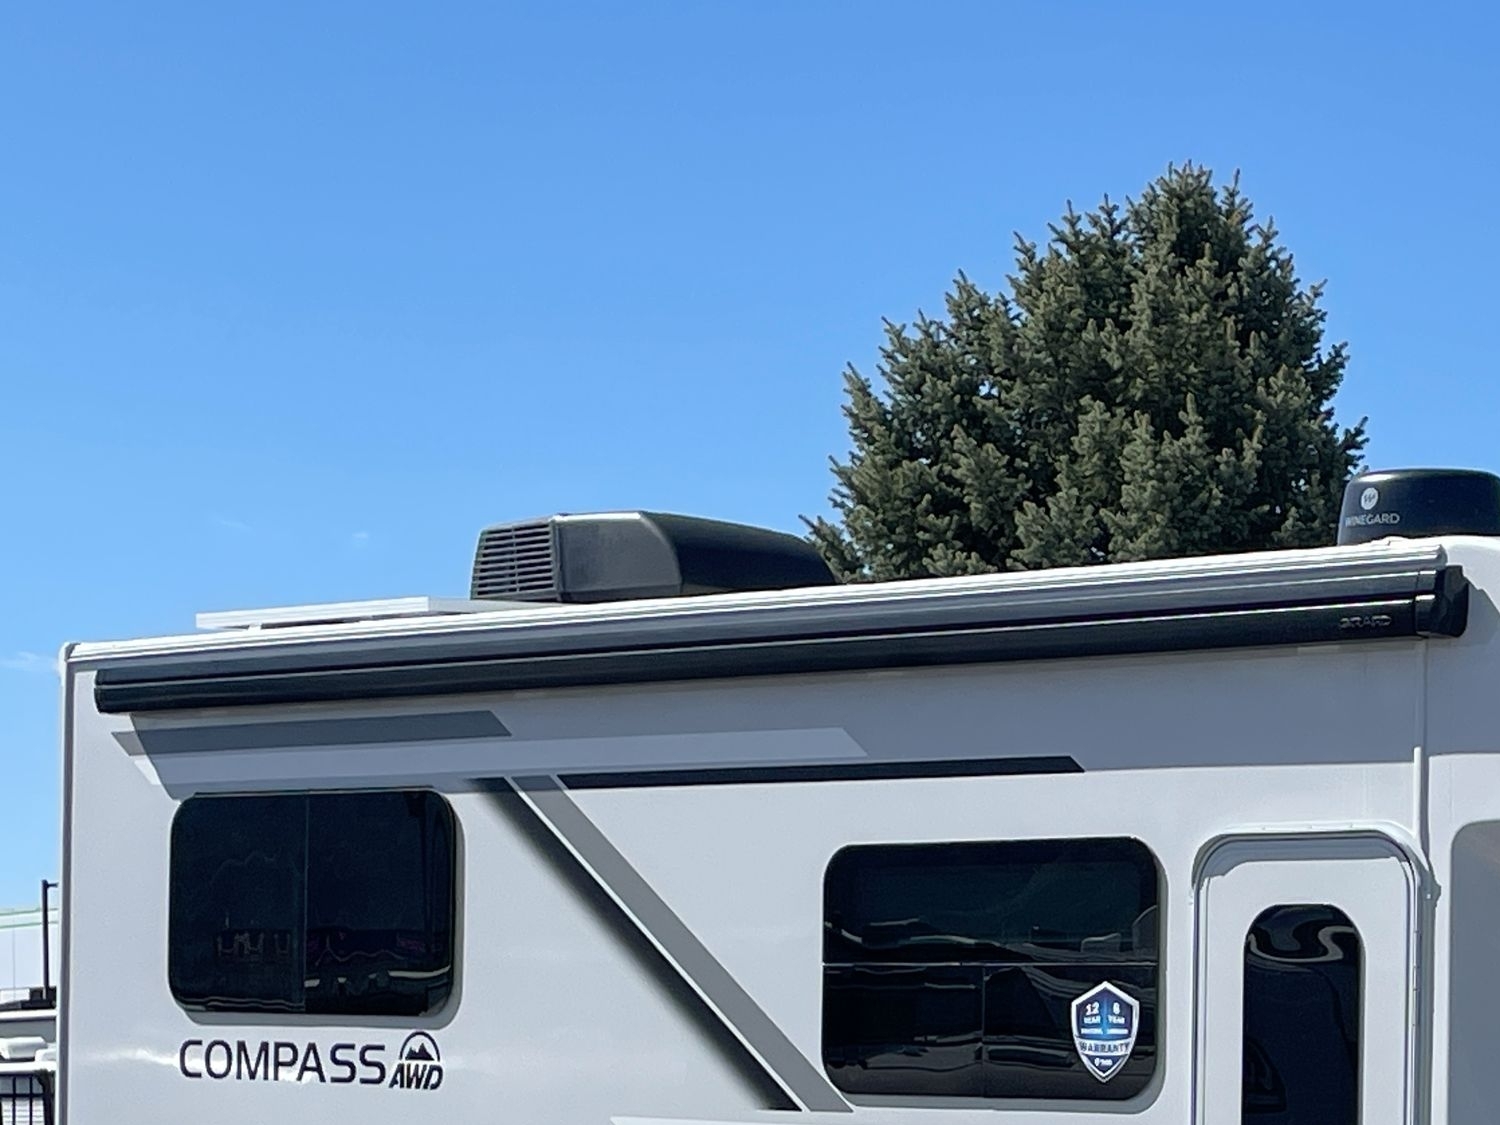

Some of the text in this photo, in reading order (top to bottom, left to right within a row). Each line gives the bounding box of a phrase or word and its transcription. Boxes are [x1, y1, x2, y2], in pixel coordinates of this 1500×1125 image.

[1080, 1041, 1130, 1053] WARRANTY
[179, 1039, 443, 1090] COMPASS AWD
